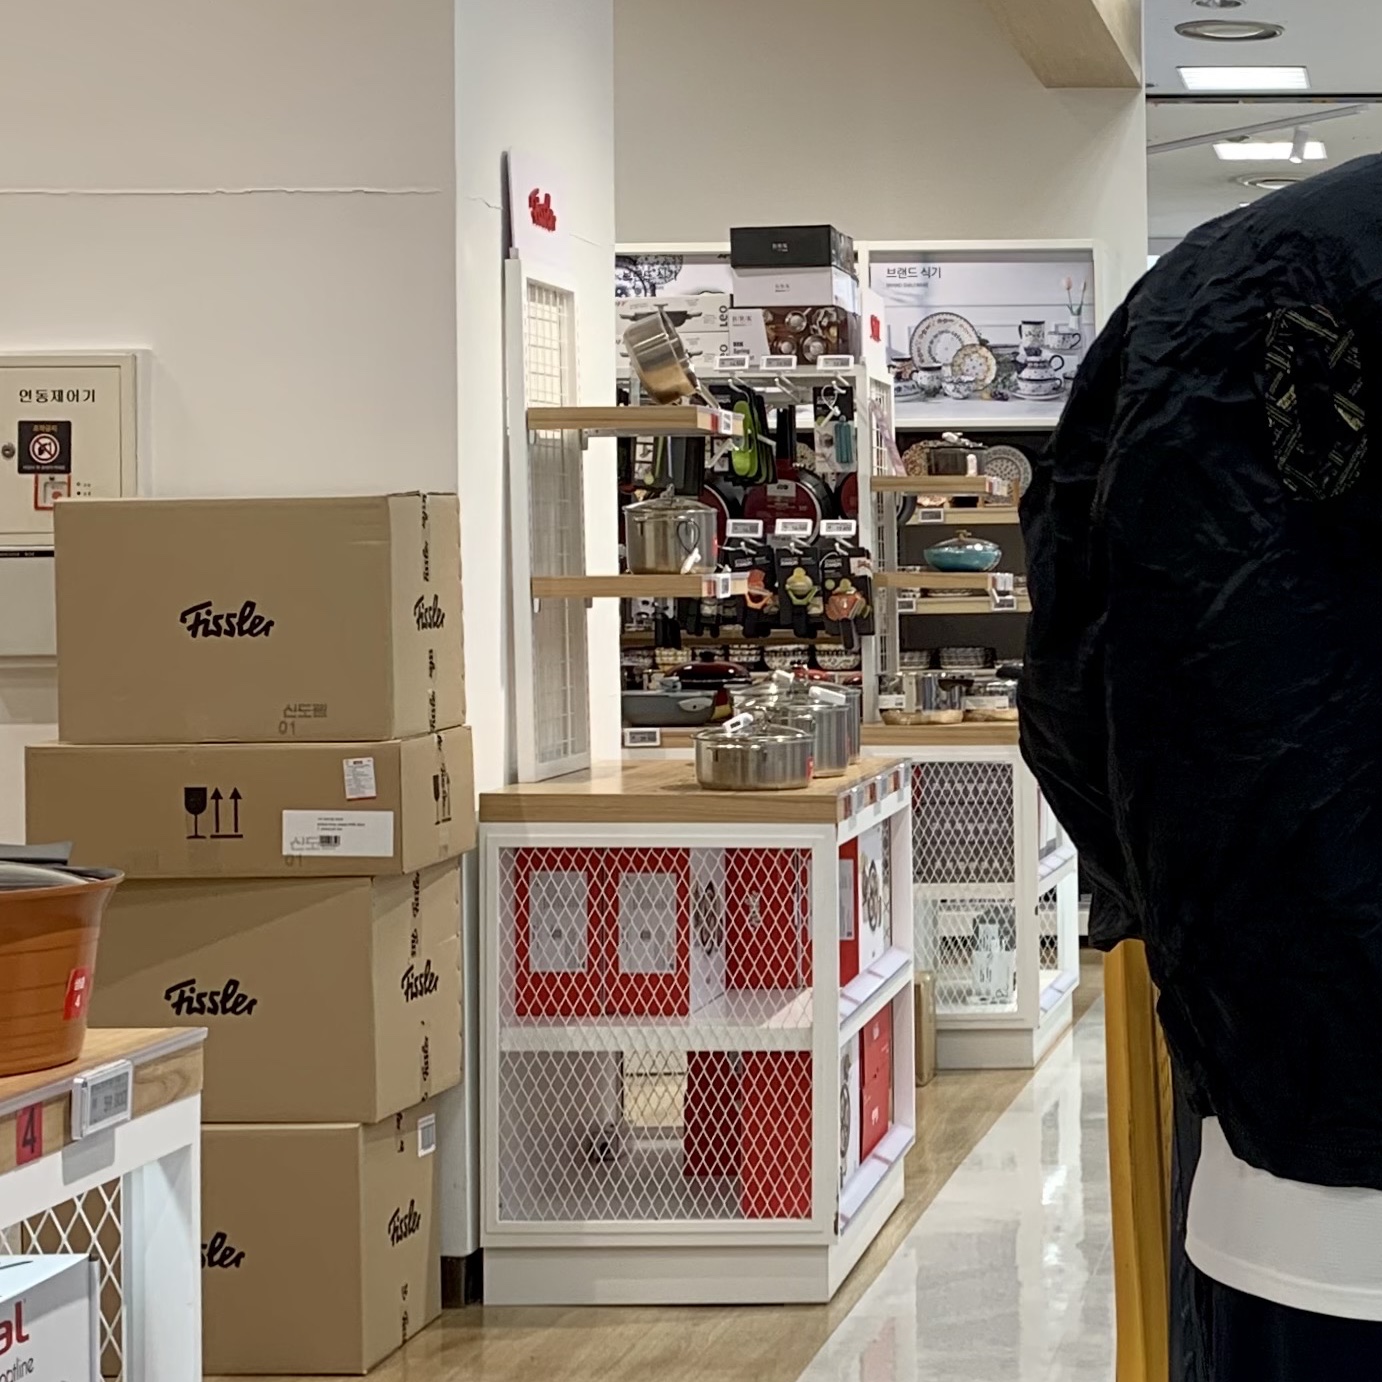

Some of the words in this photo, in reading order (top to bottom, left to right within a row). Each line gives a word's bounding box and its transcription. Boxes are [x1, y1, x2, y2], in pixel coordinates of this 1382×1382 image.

[886, 267, 918, 279] 브랜드
[920, 266, 942, 279] 식기
[180, 600, 275, 638] Fissler
[414, 594, 445, 631] Fissler
[278, 720, 296, 736] 01
[164, 978, 258, 1016] Fissler
[402, 959, 439, 1003] Fissler
[22, 1106, 37, 1153] 4
[388, 1199, 422, 1247] Fissler
